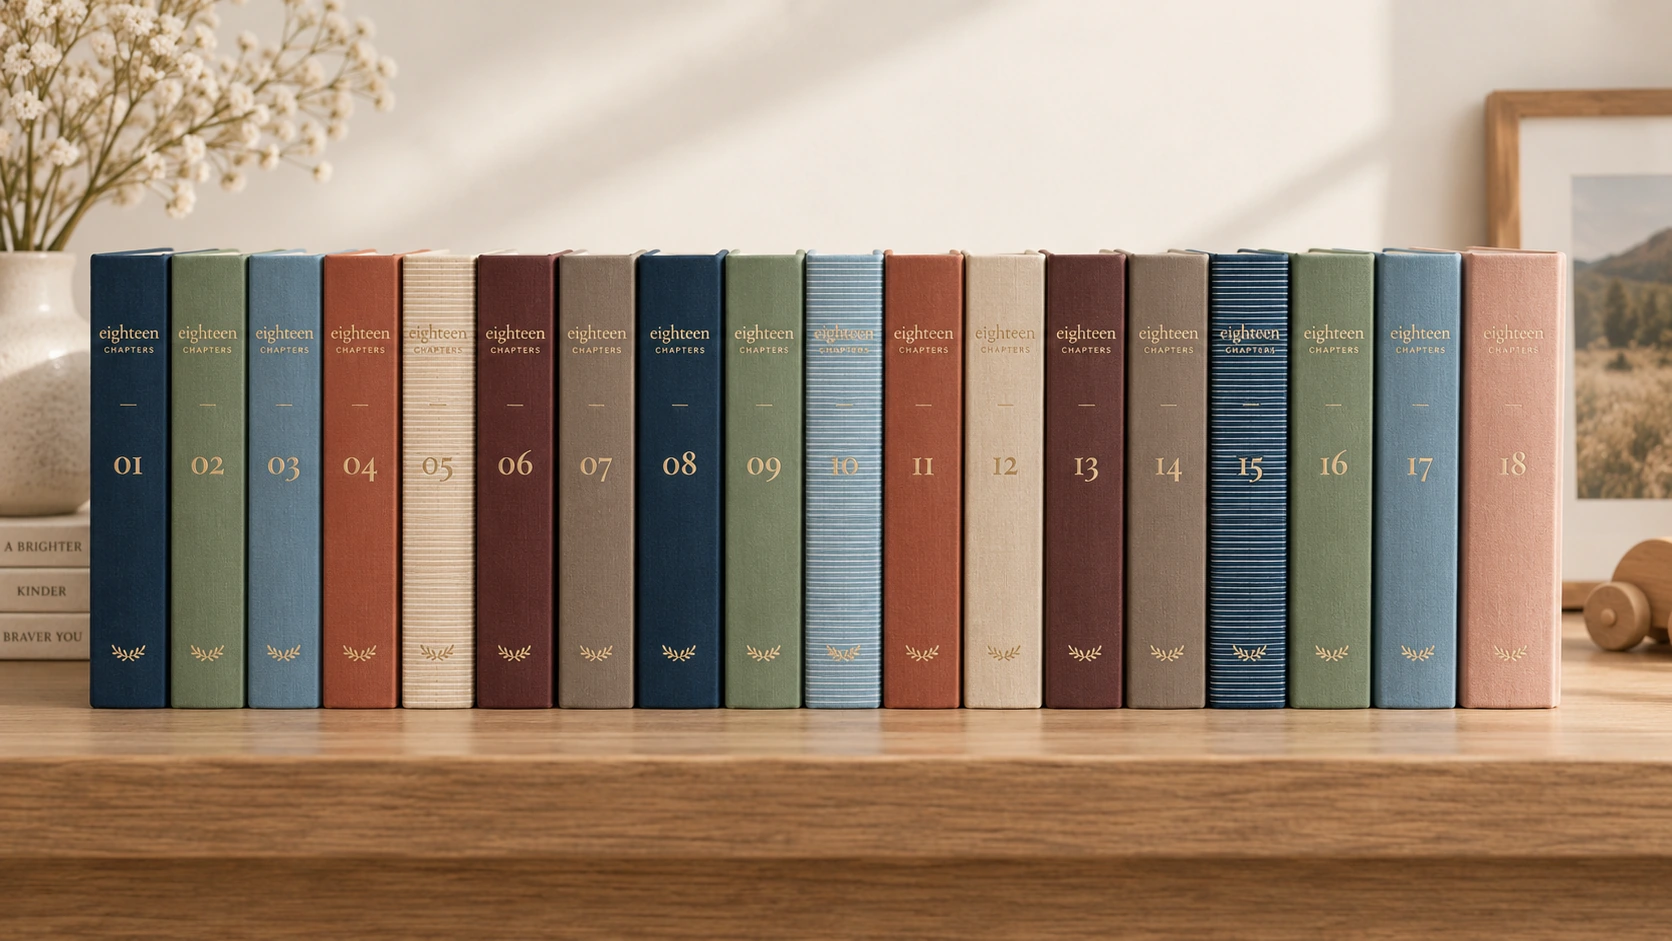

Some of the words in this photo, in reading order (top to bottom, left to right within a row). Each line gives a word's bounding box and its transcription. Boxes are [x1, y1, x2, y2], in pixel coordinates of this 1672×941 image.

[99, 324, 159, 344] eighteen
[178, 324, 238, 344] eighteen
[255, 324, 314, 344] eighteen
[331, 324, 390, 344] eighteen
[409, 324, 468, 344] eighteen
[485, 324, 546, 344] eighteen
[567, 324, 627, 344] eighteen
[650, 324, 710, 344] eighteen
[734, 324, 794, 344] eighteen
[894, 324, 954, 344] eighteen
[975, 324, 1036, 344] eighteen
[1056, 324, 1116, 344] eighteen
[1139, 324, 1199, 344] eighteen
[1304, 324, 1365, 344] eighteen
[1390, 324, 1451, 344] eighteen
[1483, 324, 1544, 344] eighteen
[104, 346, 154, 354] CHAPTERS
[182, 346, 232, 354] CHAPTERS
[260, 346, 309, 354] CHAPTERS
[336, 346, 385, 354] CHAPTERS
[414, 346, 463, 354] CHAPTERS
[490, 346, 541, 354] CHAPTERS
[572, 346, 622, 354] CHAPTERS
[655, 346, 705, 354] CHAPTERS
[739, 346, 789, 354] CHAPTERS
[899, 346, 949, 354] CHAPTERS
[980, 346, 1031, 354] CHAPTERS
[1061, 346, 1111, 354] CHAPTERS
[1144, 346, 1194, 354] CHAPTERS
[1309, 346, 1359, 354] CHAPTERS
[1395, 346, 1445, 354] CHAPTERS
[1488, 346, 1538, 354] CHAPTERS
[114, 455, 143, 475] 01
[190, 455, 225, 475] 02
[267, 455, 301, 482] 03
[343, 455, 378, 482] 04
[422, 455, 453, 482] 05
[498, 450, 533, 475] 06
[580, 455, 613, 482] 07
[662, 451, 697, 476] 08
[747, 455, 782, 482] 09
[831, 456, 859, 476] 10
[992, 455, 1019, 476] 12
[1074, 456, 1099, 482] 13
[1155, 456, 1183, 482] 14
[1237, 455, 1264, 482] 15
[1320, 450, 1348, 476] 16
[1407, 456, 1433, 482] 17
[1500, 451, 1527, 476] 18
[4, 541, 12, 552] A
[18, 541, 82, 552] BRIGHTER
[17, 586, 66, 596] KINDER
[4, 632, 52, 642] BRAVER
[56, 632, 82, 642] YOU
